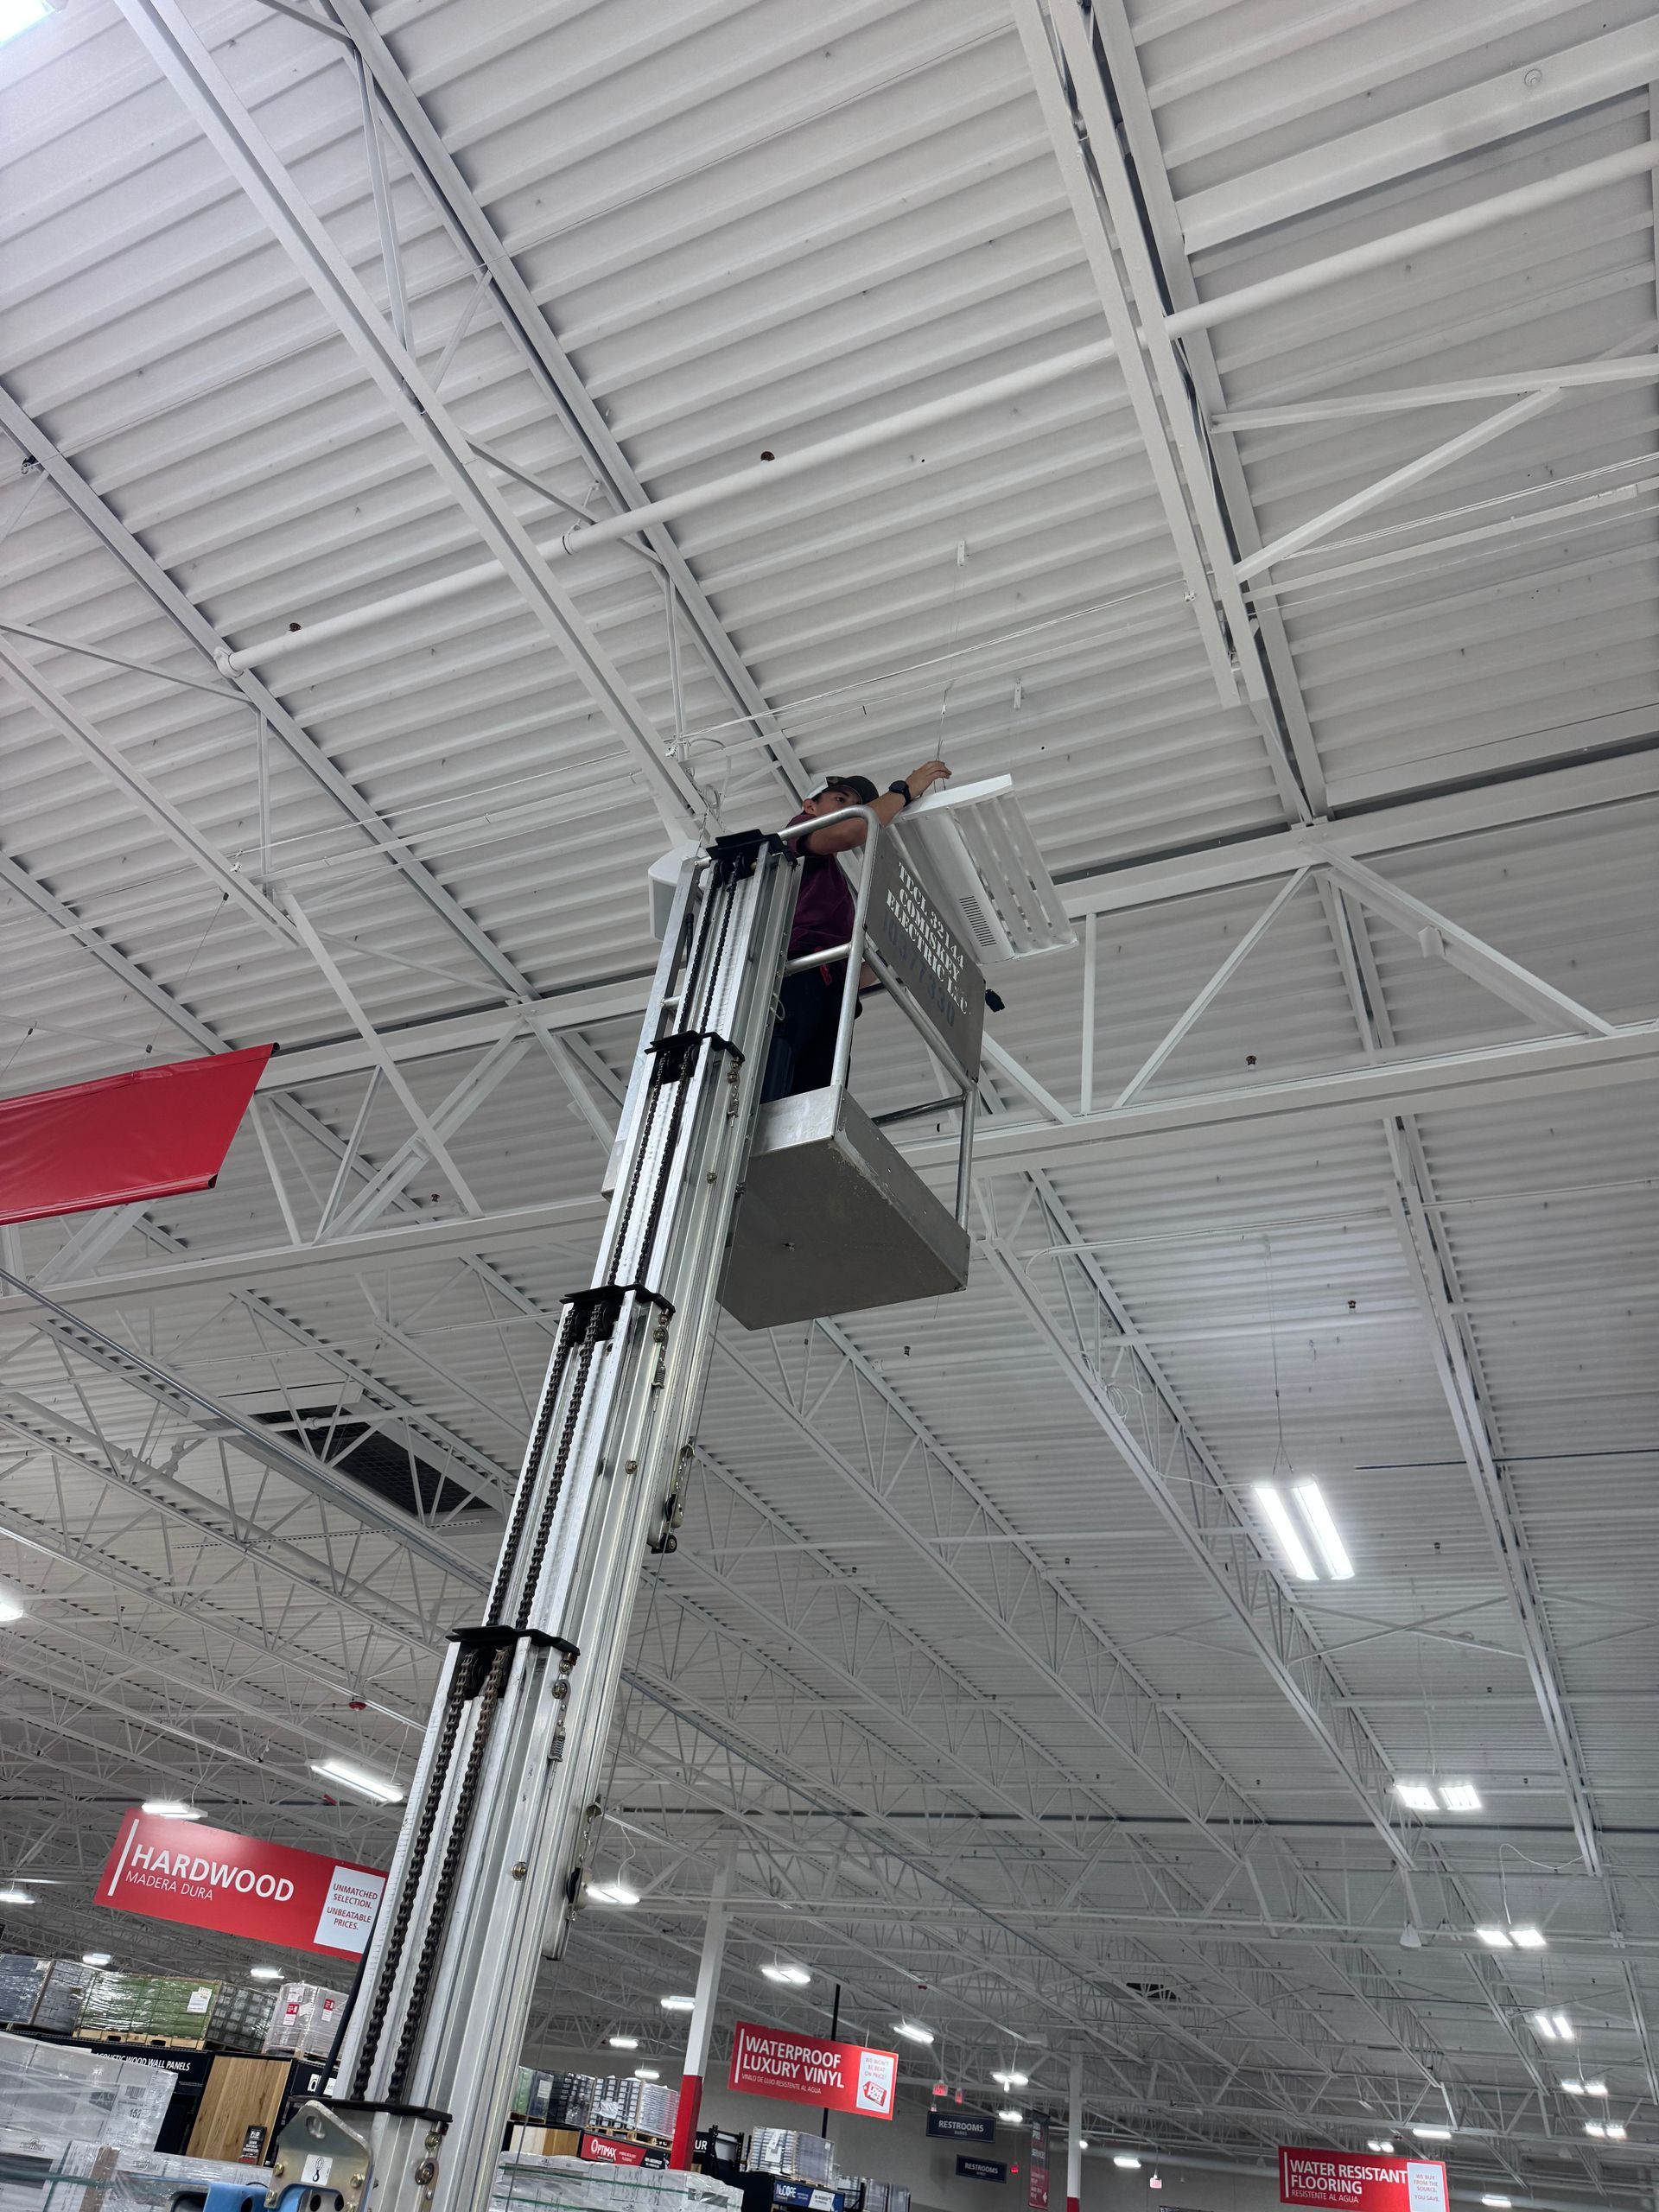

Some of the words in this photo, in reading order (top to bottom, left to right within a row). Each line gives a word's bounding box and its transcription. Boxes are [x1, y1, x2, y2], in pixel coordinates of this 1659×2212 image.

[887, 888, 945, 982] ELECTRIC
[899, 888, 960, 982] COMISKEY
[931, 911, 964, 969] 32144
[130, 1844, 295, 1902] HARDWOOD
[125, 1870, 176, 1892] MADERA
[181, 1882, 213, 1902] DURA
[333, 1884, 378, 1900] UNMATCHED
[333, 1893, 372, 1909] SELECTION.
[327, 1906, 372, 1923] UNBEATABLE
[333, 1917, 359, 1930] PRICES.
[746, 2035, 842, 2069] WATERPROOF
[166, 2060, 191, 2071] PANELS
[743, 2053, 800, 2079] LUXURY
[804, 2065, 845, 2088] VINYL
[938, 2120, 984, 2133] RESTROOMS
[1290, 2159, 1336, 2177] WATER
[1338, 2164, 1408, 2184] RESISTANT
[1291, 2175, 1363, 2195] FLOORING
[1291, 2190, 1327, 2201] RESISTENTE
